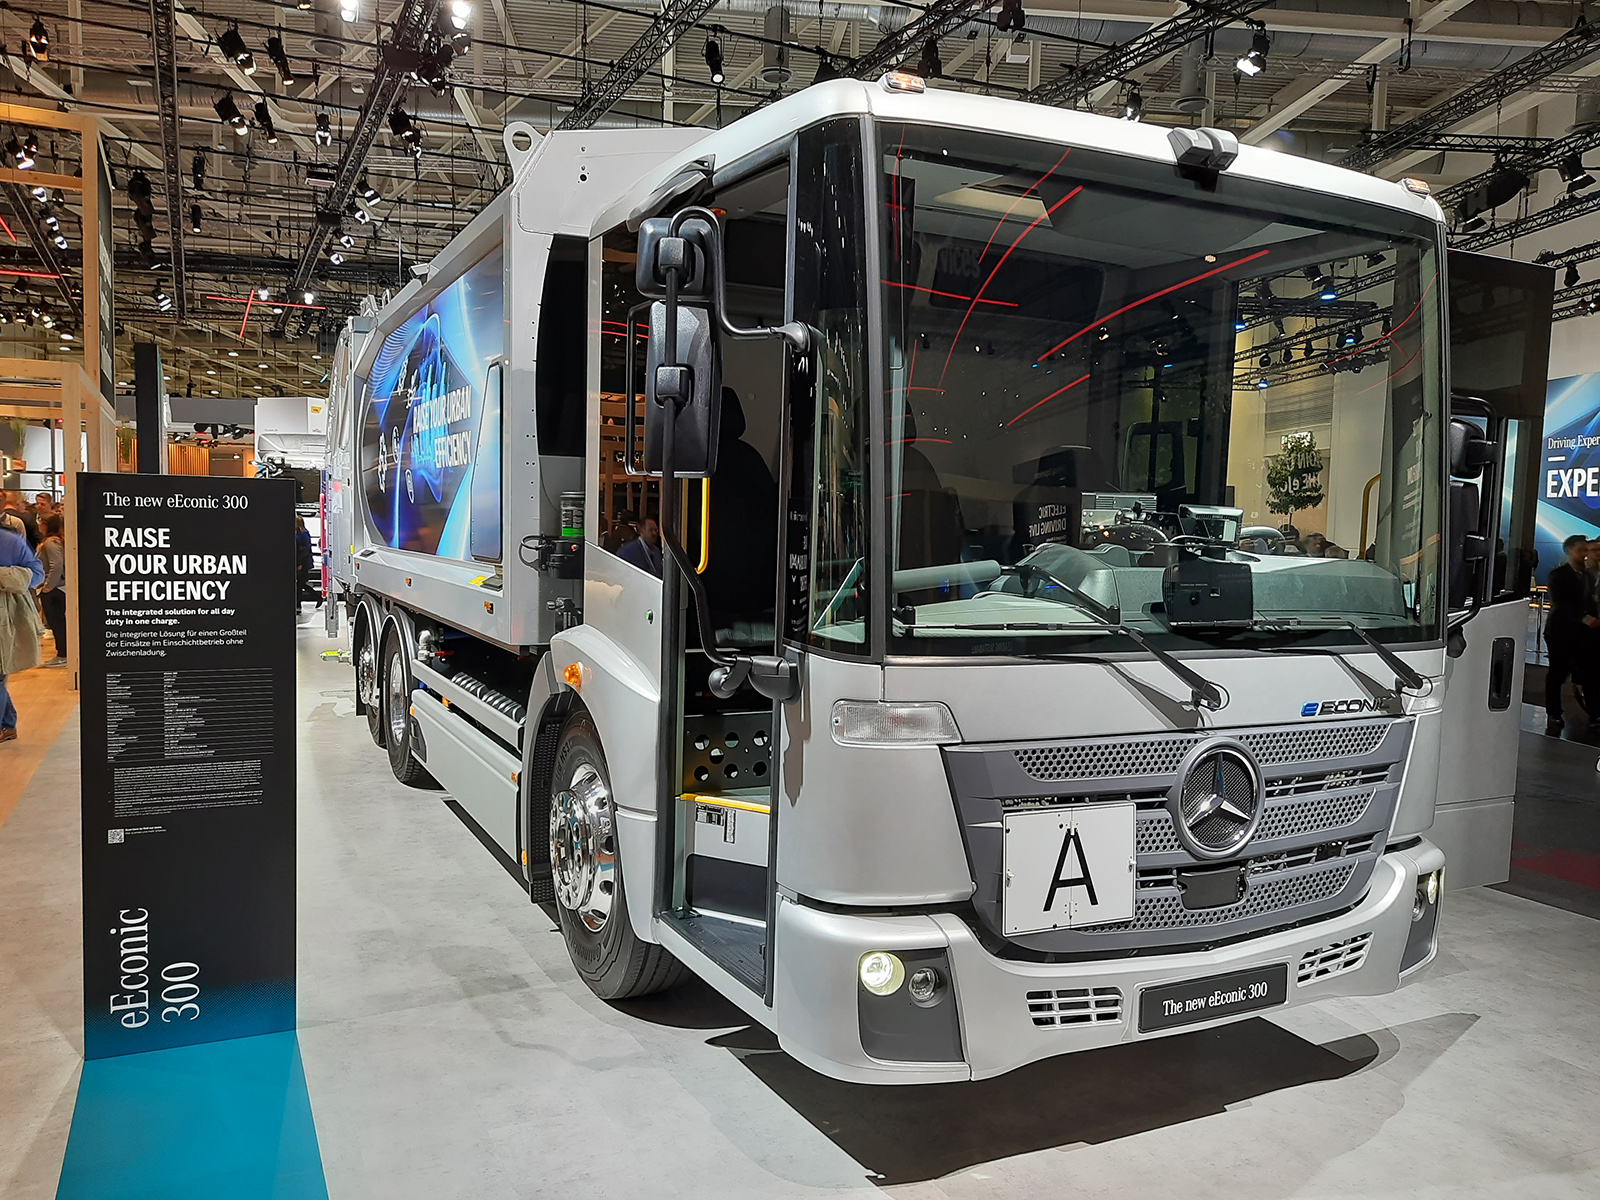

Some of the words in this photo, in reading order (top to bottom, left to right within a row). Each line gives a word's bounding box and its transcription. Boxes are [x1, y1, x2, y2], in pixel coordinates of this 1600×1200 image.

[413, 401, 429, 434] RAISE
[430, 395, 446, 429] YOUR
[447, 384, 472, 425] URBAN
[435, 430, 472, 468] EFFICIENCY
[1548, 436, 1576, 450] Driving
[1546, 467, 1600, 498] EXPE
[103, 491, 131, 507] The
[134, 494, 163, 507] new
[166, 493, 219, 509] eEconic
[222, 494, 248, 510] 300
[104, 527, 171, 548] RAISE
[104, 554, 168, 575] YOUR
[173, 554, 247, 575] URBAN
[105, 580, 231, 601] EFFICIENCY
[105, 618, 124, 626] duty
[151, 618, 180, 626] charge.
[122, 608, 163, 617] integrated
[221, 608, 235, 616] day
[105, 640, 118, 648] der
[162, 639, 224, 647] Einschichtbetrieb
[120, 630, 158, 639] integrierte
[159, 630, 185, 638] Lösung
[105, 649, 167, 658] Zwischenladung.
[1043, 827, 1099, 912] A
[110, 907, 149, 1028] eEconic
[160, 961, 200, 1022] 300
[1162, 999, 1183, 1016] The
[1185, 997, 1207, 1012] new
[1208, 987, 1247, 1007] eEconic
[1248, 981, 1268, 1000] 300
